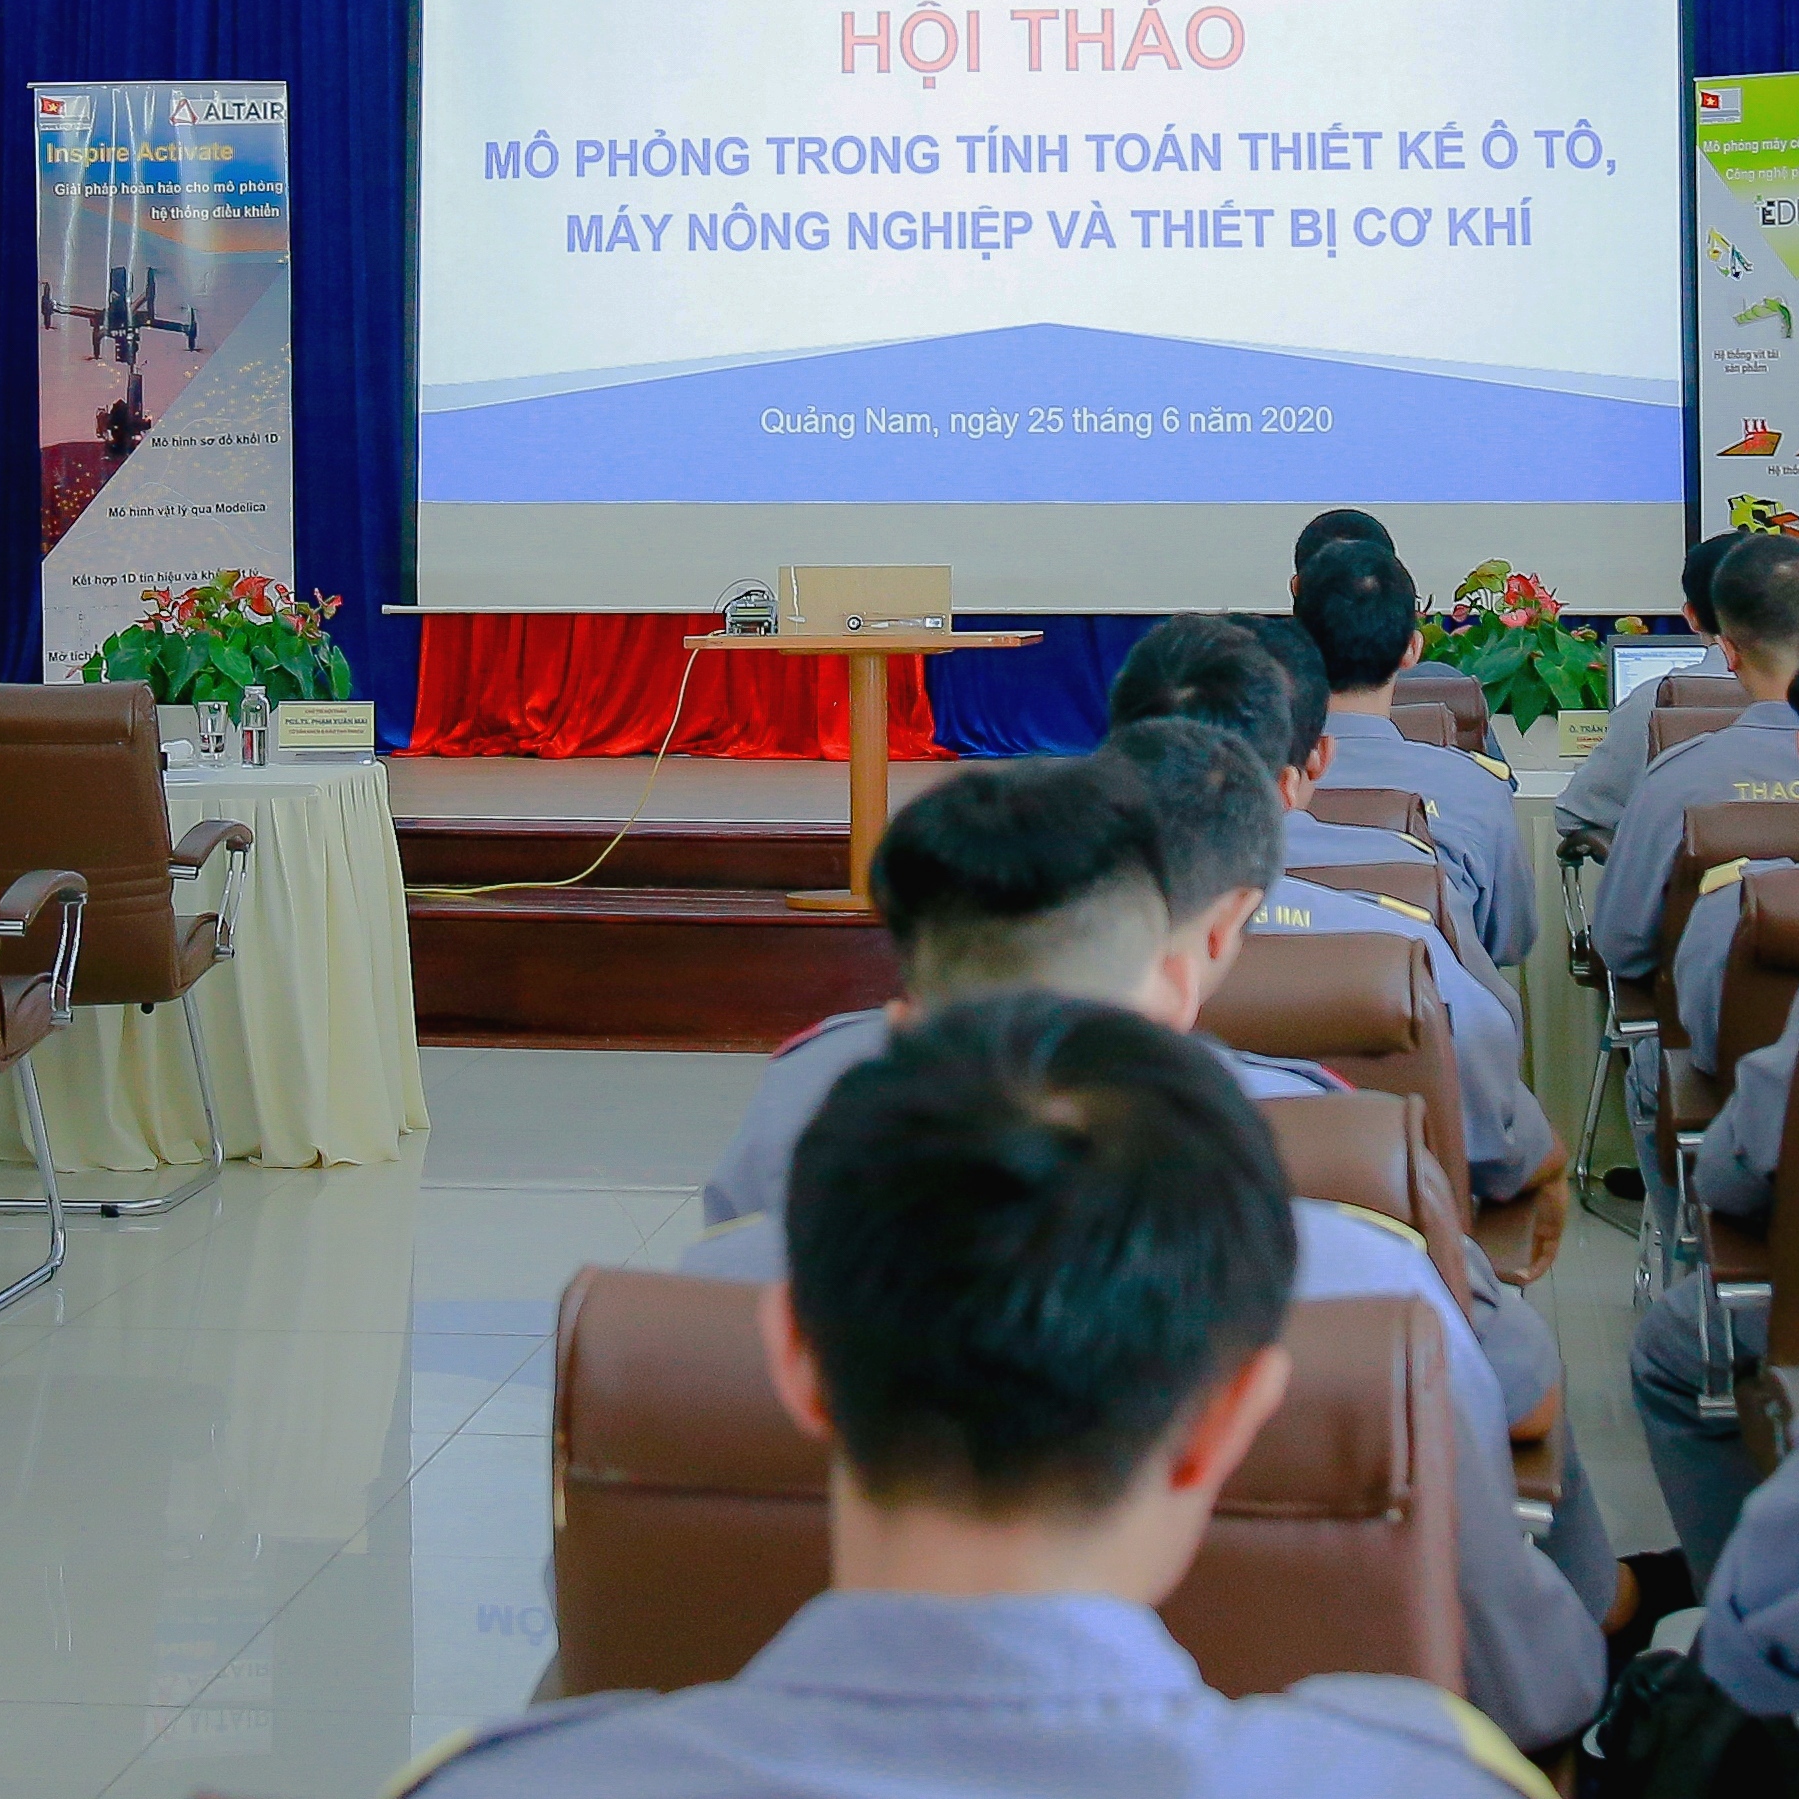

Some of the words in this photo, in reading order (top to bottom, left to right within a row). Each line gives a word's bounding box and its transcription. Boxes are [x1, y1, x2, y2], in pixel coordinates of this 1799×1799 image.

[841, 2, 981, 89] HỘI
[204, 102, 284, 120] ALTAIR
[47, 144, 129, 167] Inspire
[137, 142, 234, 161] Activate
[484, 129, 560, 181] MÔ
[575, 127, 750, 179] PHỎNG
[767, 133, 940, 177] TRONG
[956, 125, 1068, 175] TÍNH
[1085, 123, 1222, 175] TOÁN
[1239, 121, 1379, 173] THIẾT
[1399, 122, 1466, 171] KẾ
[1482, 120, 1518, 170] Ô
[1533, 119, 1617, 175] TÔ,
[567, 206, 672, 255] MÁY
[687, 202, 831, 254] NÔNG
[847, 202, 1033, 260] NGHIỆP
[1048, 201, 1117, 251] VÀ
[1131, 199, 1275, 250] THIẾT
[1292, 207, 1336, 258] BỊ
[1354, 204, 1434, 248] CƠ
[1448, 197, 1531, 247] KHÍ
[761, 403, 854, 443] Quảng
[862, 407, 939, 441] Nam,
[948, 406, 1019, 441] ngày
[1028, 407, 1064, 436] 25
[1072, 404, 1153, 441] tháng
[1162, 407, 1180, 435] 6
[1188, 407, 1253, 436] năm
[1261, 405, 1332, 434] 2020
[216, 503, 265, 514] Modelica
